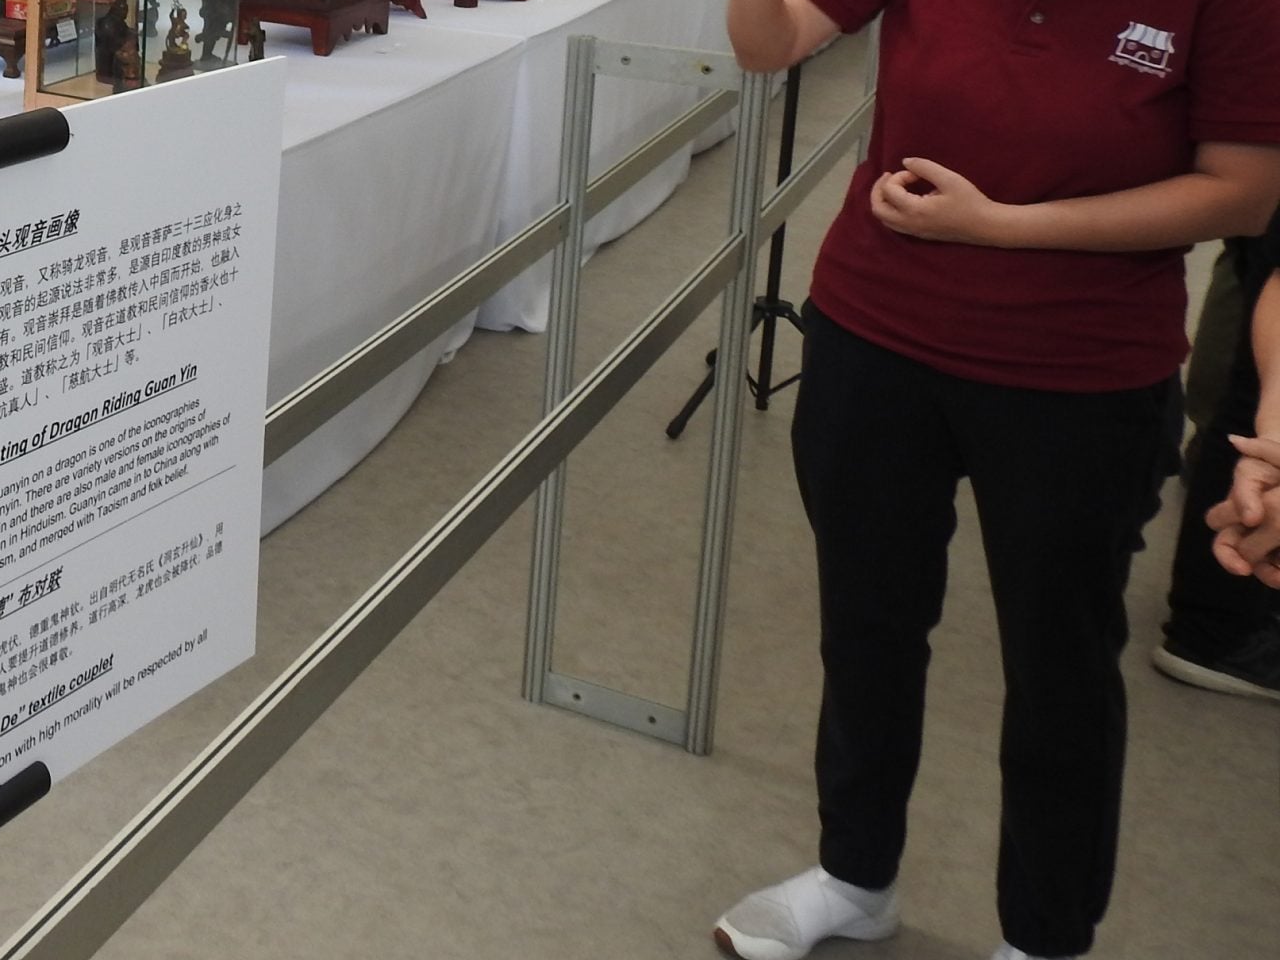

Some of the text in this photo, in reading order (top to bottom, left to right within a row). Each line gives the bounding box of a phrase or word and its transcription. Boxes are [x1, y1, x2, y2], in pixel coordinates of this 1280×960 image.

[28, 424, 49, 449] of
[45, 407, 99, 442] Dragon
[101, 388, 143, 417] Riding
[142, 373, 177, 399] Guan
[179, 363, 198, 383] Yin
[31, 469, 44, 483] on
[46, 466, 53, 477] a
[54, 450, 87, 473] dragon
[88, 445, 97, 457] is
[98, 437, 116, 452] one
[117, 428, 127, 443] of
[128, 425, 142, 439] the
[143, 398, 200, 432] iconographies
[18, 538, 38, 559] and
[39, 519, 75, 549] merged
[76, 511, 95, 529] with
[96, 496, 129, 519] Taoism
[130, 483, 147, 502] and
[148, 477, 163, 494] folk
[164, 463, 189, 485] belief.
[17, 565, 64, 606] 布对联
[14, 735, 36, 758] with
[38, 720, 61, 743] high
[63, 695, 103, 727] morality
[104, 681, 121, 701] will
[123, 675, 135, 690] be
[137, 643, 183, 682] respected
[184, 638, 196, 653] by
[197, 628, 208, 645] all
[28, 684, 66, 716] textile
[69, 652, 114, 691] couplet
